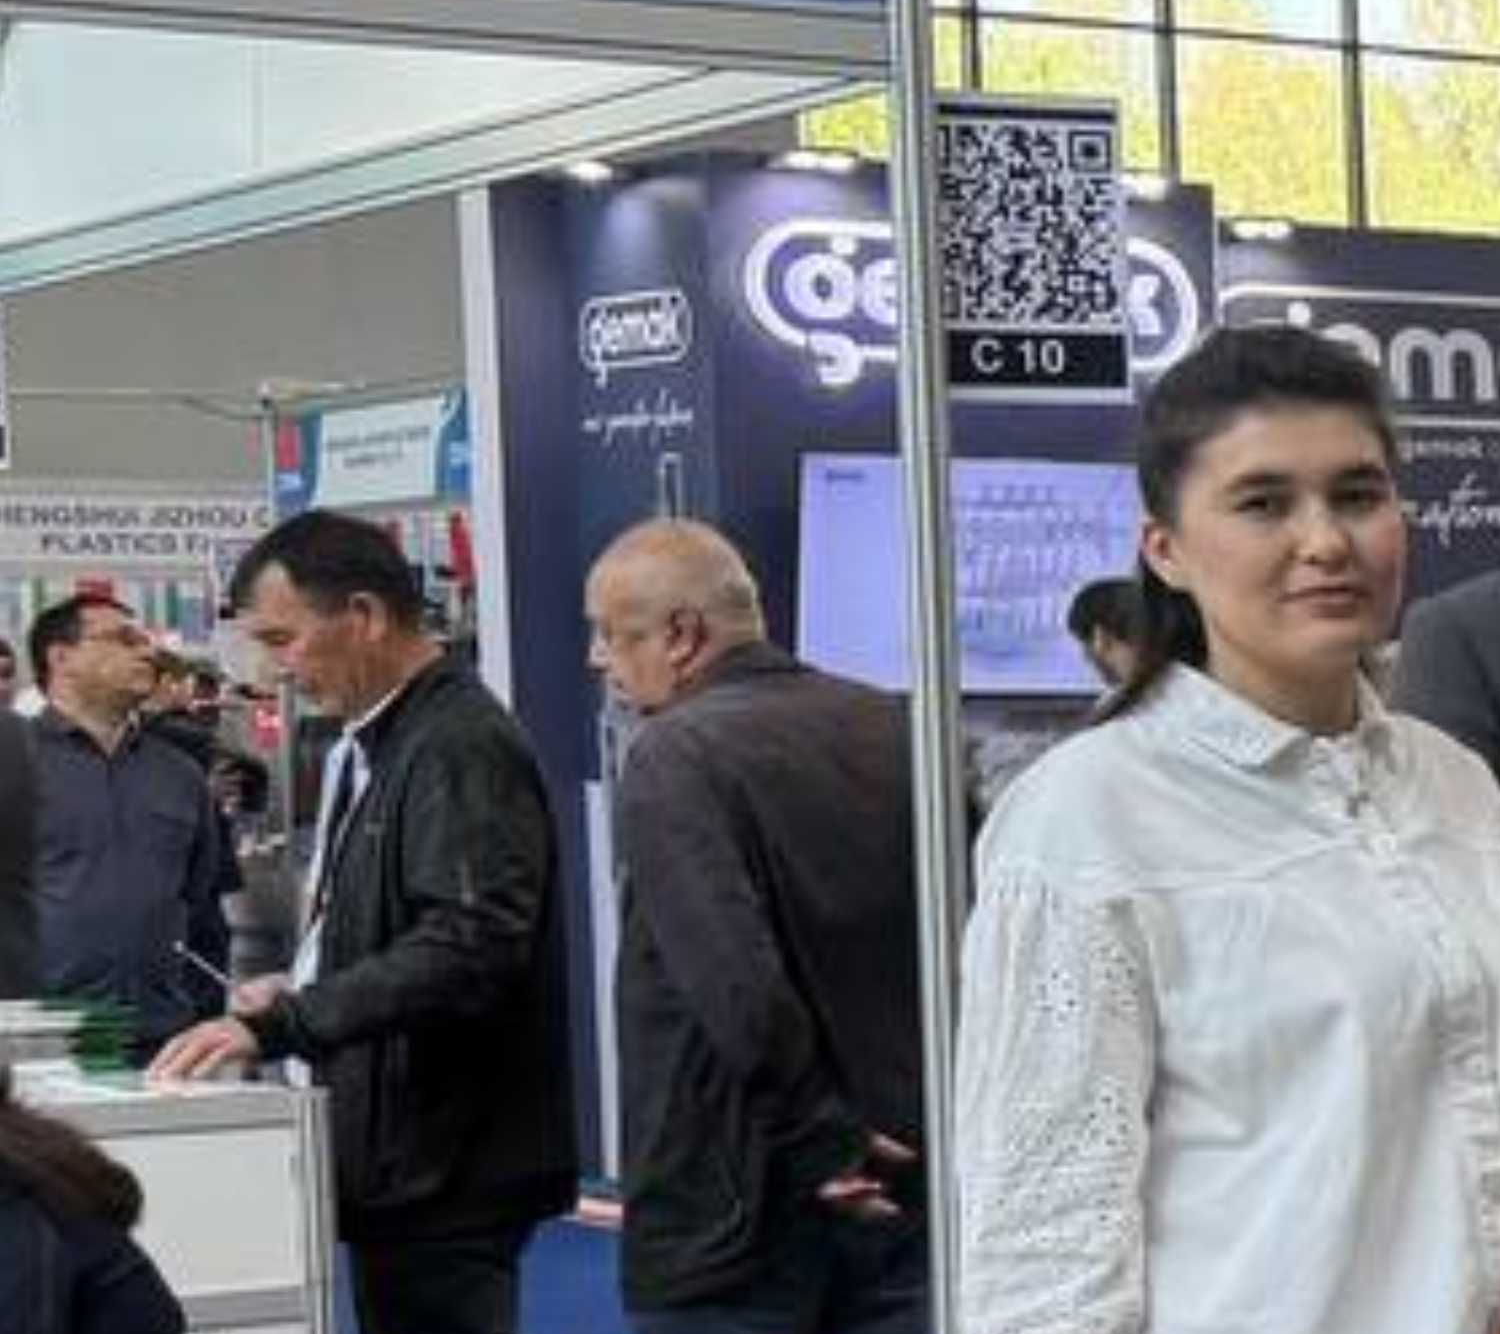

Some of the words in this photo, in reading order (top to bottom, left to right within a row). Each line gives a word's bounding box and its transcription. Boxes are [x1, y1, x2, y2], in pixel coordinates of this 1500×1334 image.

[969, 338, 1003, 374] C
[1017, 338, 1066, 375] 10
[41, 533, 177, 555] PLASTICS
